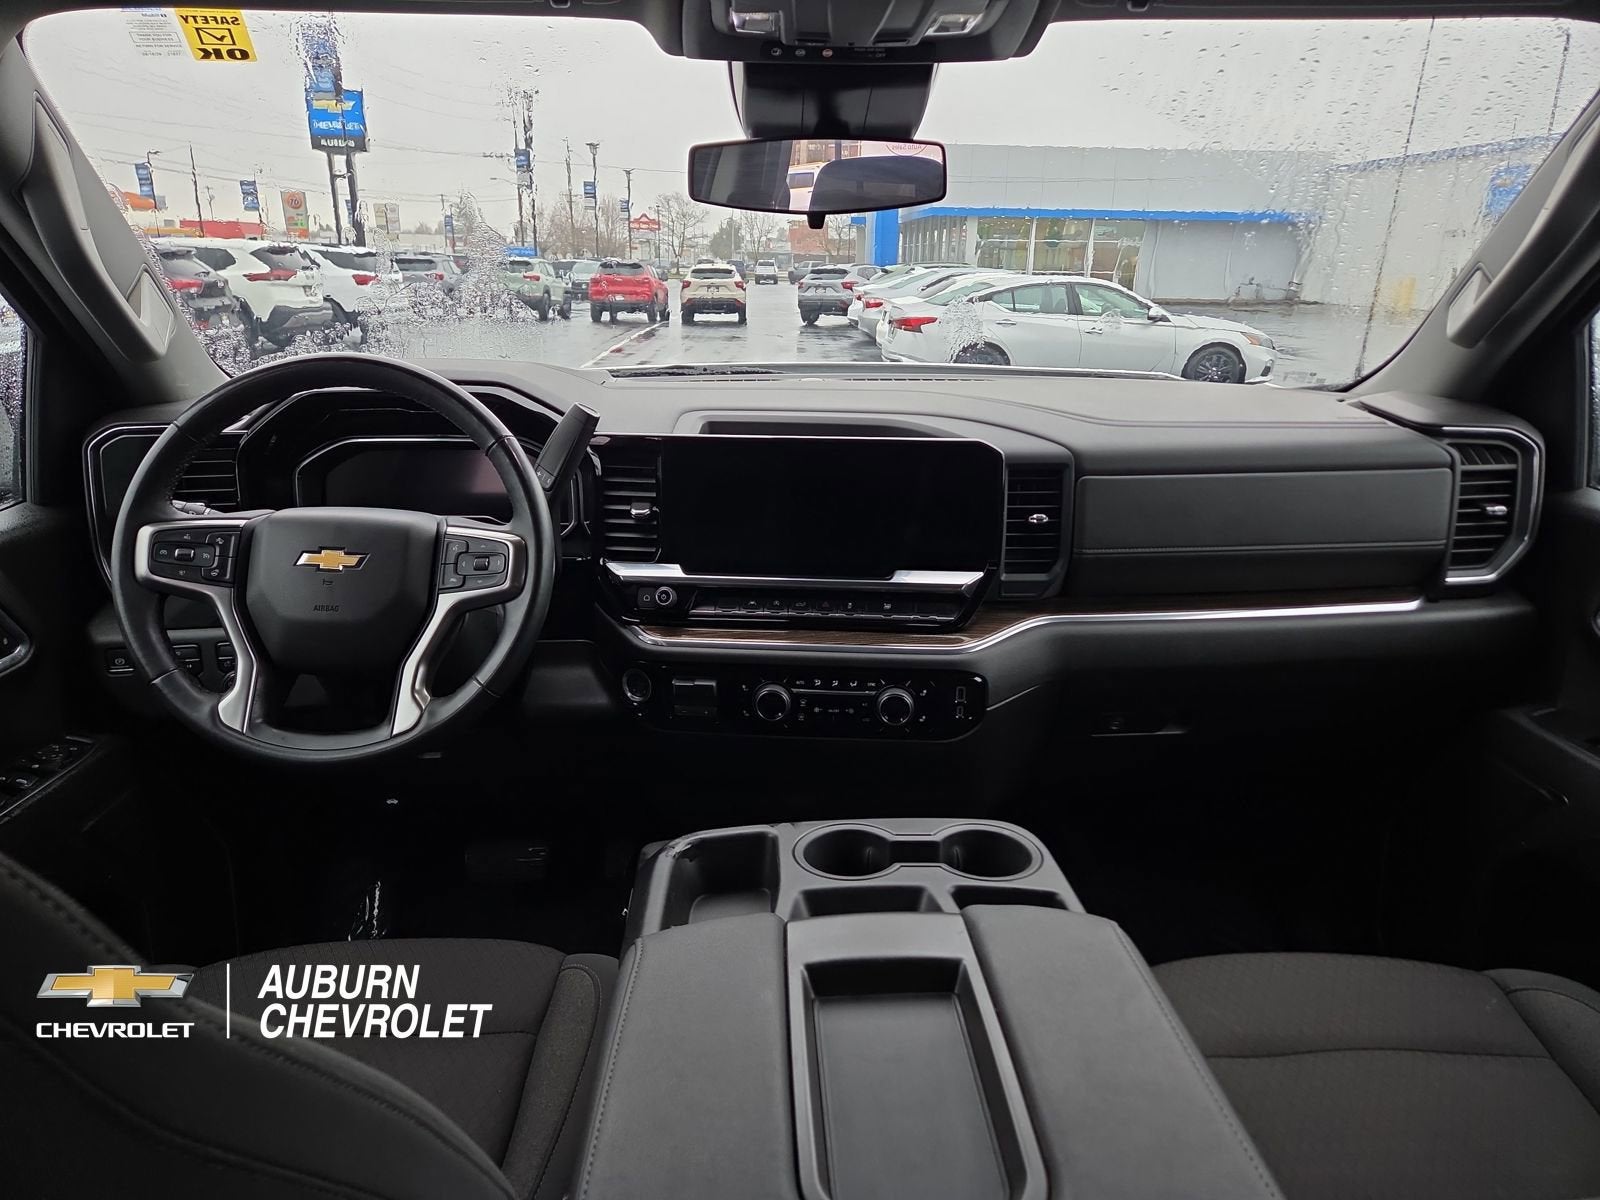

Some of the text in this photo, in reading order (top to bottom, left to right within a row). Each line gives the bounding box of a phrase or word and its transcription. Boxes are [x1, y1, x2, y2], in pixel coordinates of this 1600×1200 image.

[313, 119, 360, 131] CHEVRLET
[289, 198, 300, 206] 76
[313, 604, 339, 613] AIRBAG
